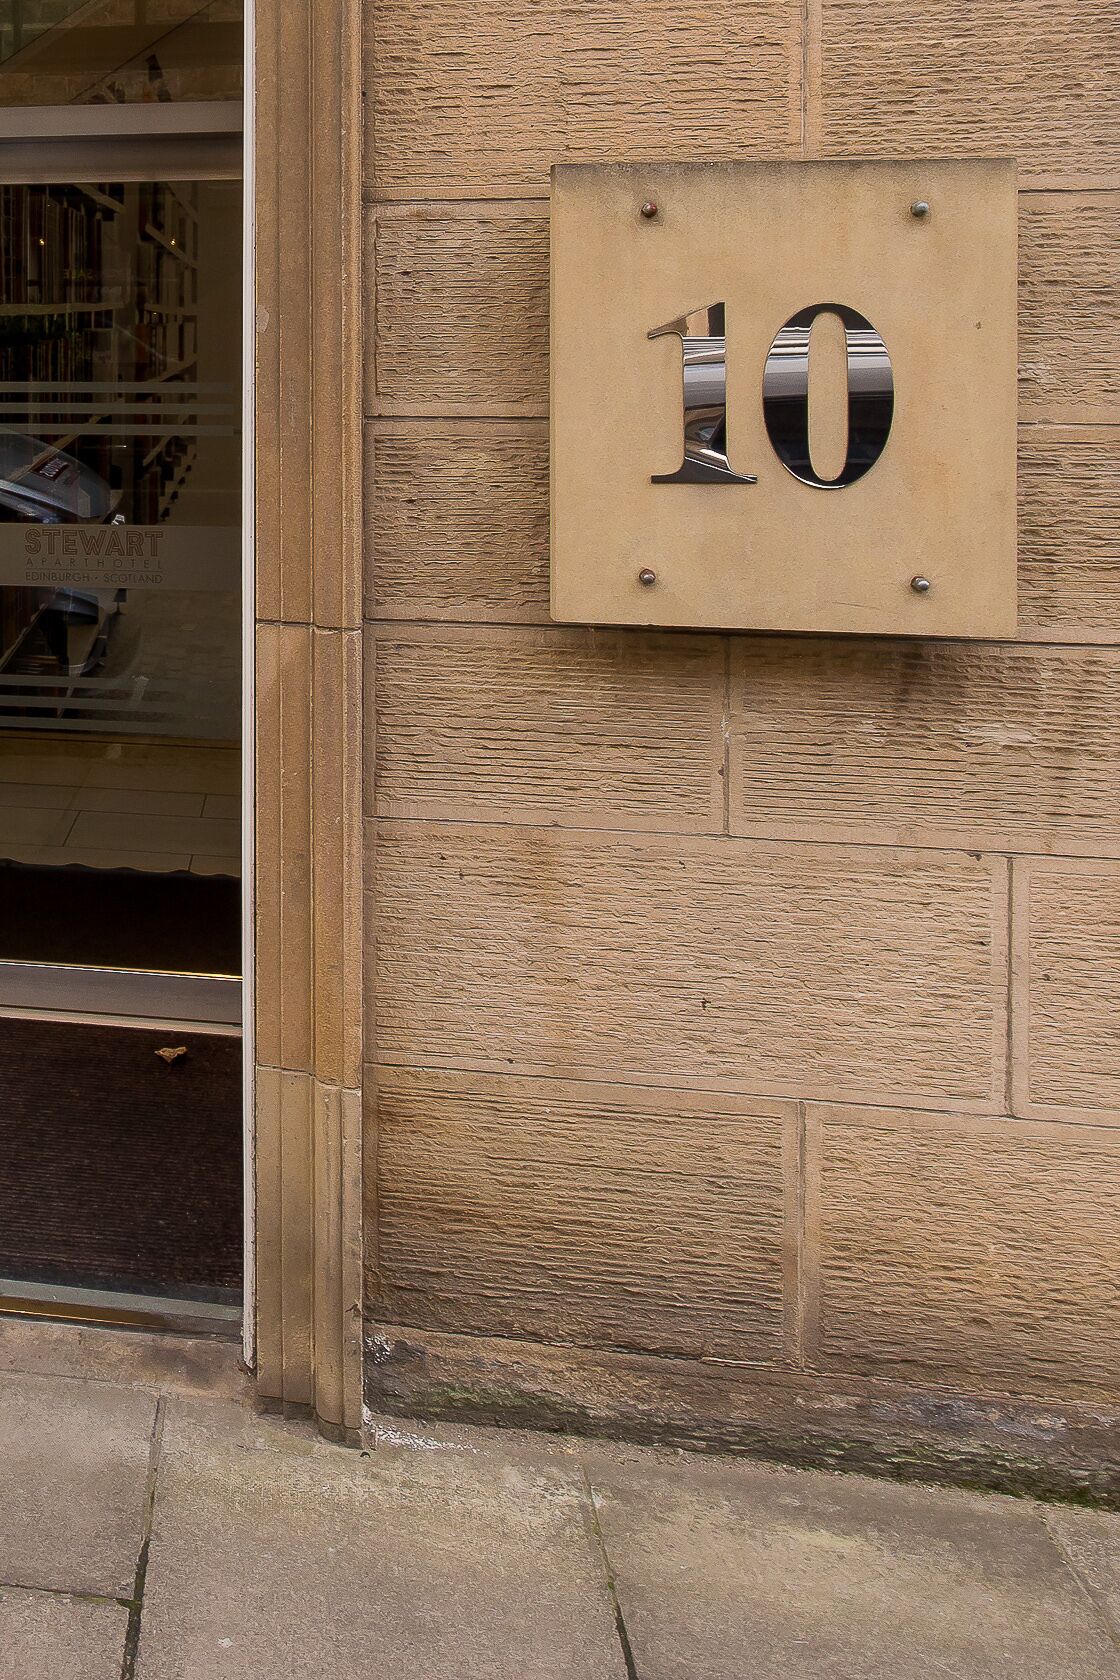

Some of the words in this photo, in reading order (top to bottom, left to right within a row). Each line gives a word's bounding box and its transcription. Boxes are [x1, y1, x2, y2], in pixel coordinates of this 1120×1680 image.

[647, 301, 895, 489] 10
[24, 528, 164, 558] STEWART
[26, 558, 162, 570] APARTHOTEL
[24, 571, 92, 583] EDINBURGH
[103, 573, 164, 585] SCOTLAND
